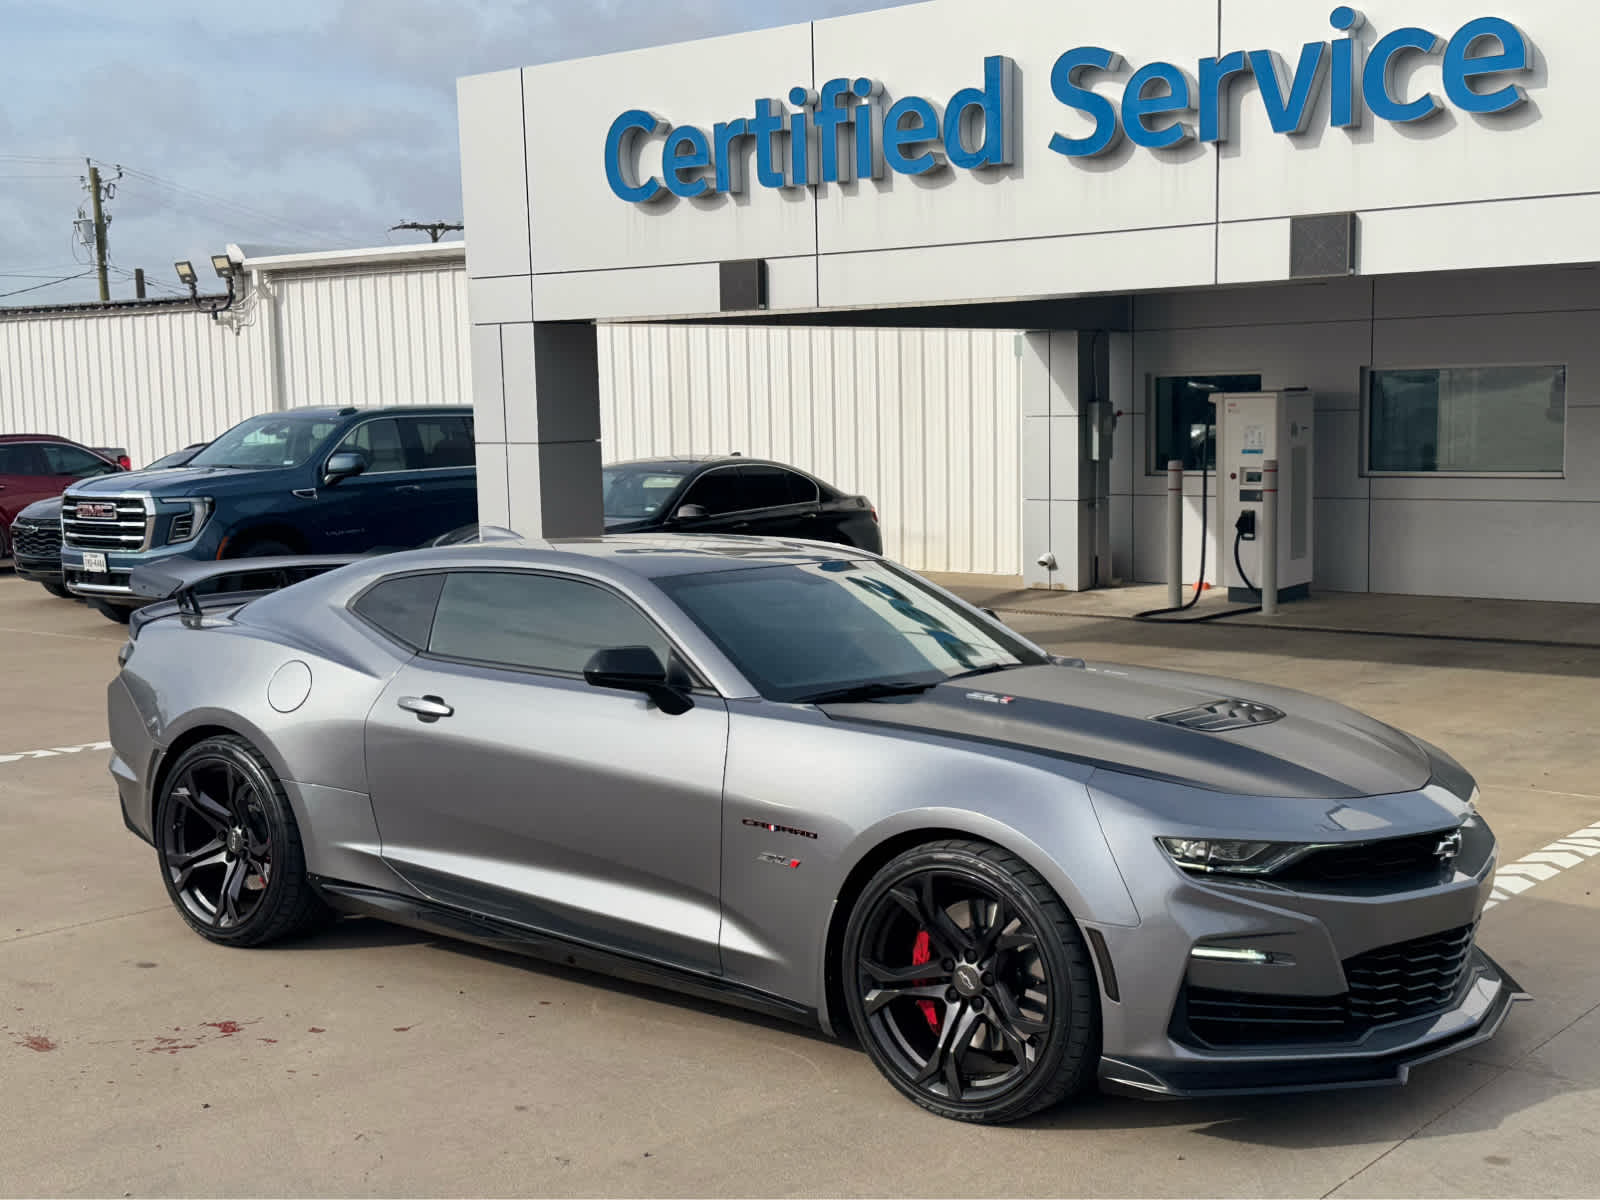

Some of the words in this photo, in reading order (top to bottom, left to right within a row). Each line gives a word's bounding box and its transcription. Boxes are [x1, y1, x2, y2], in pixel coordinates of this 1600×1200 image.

[604, 55, 1008, 202] Certified
[1048, 5, 1529, 157] Service
[77, 504, 113, 518] GMC
